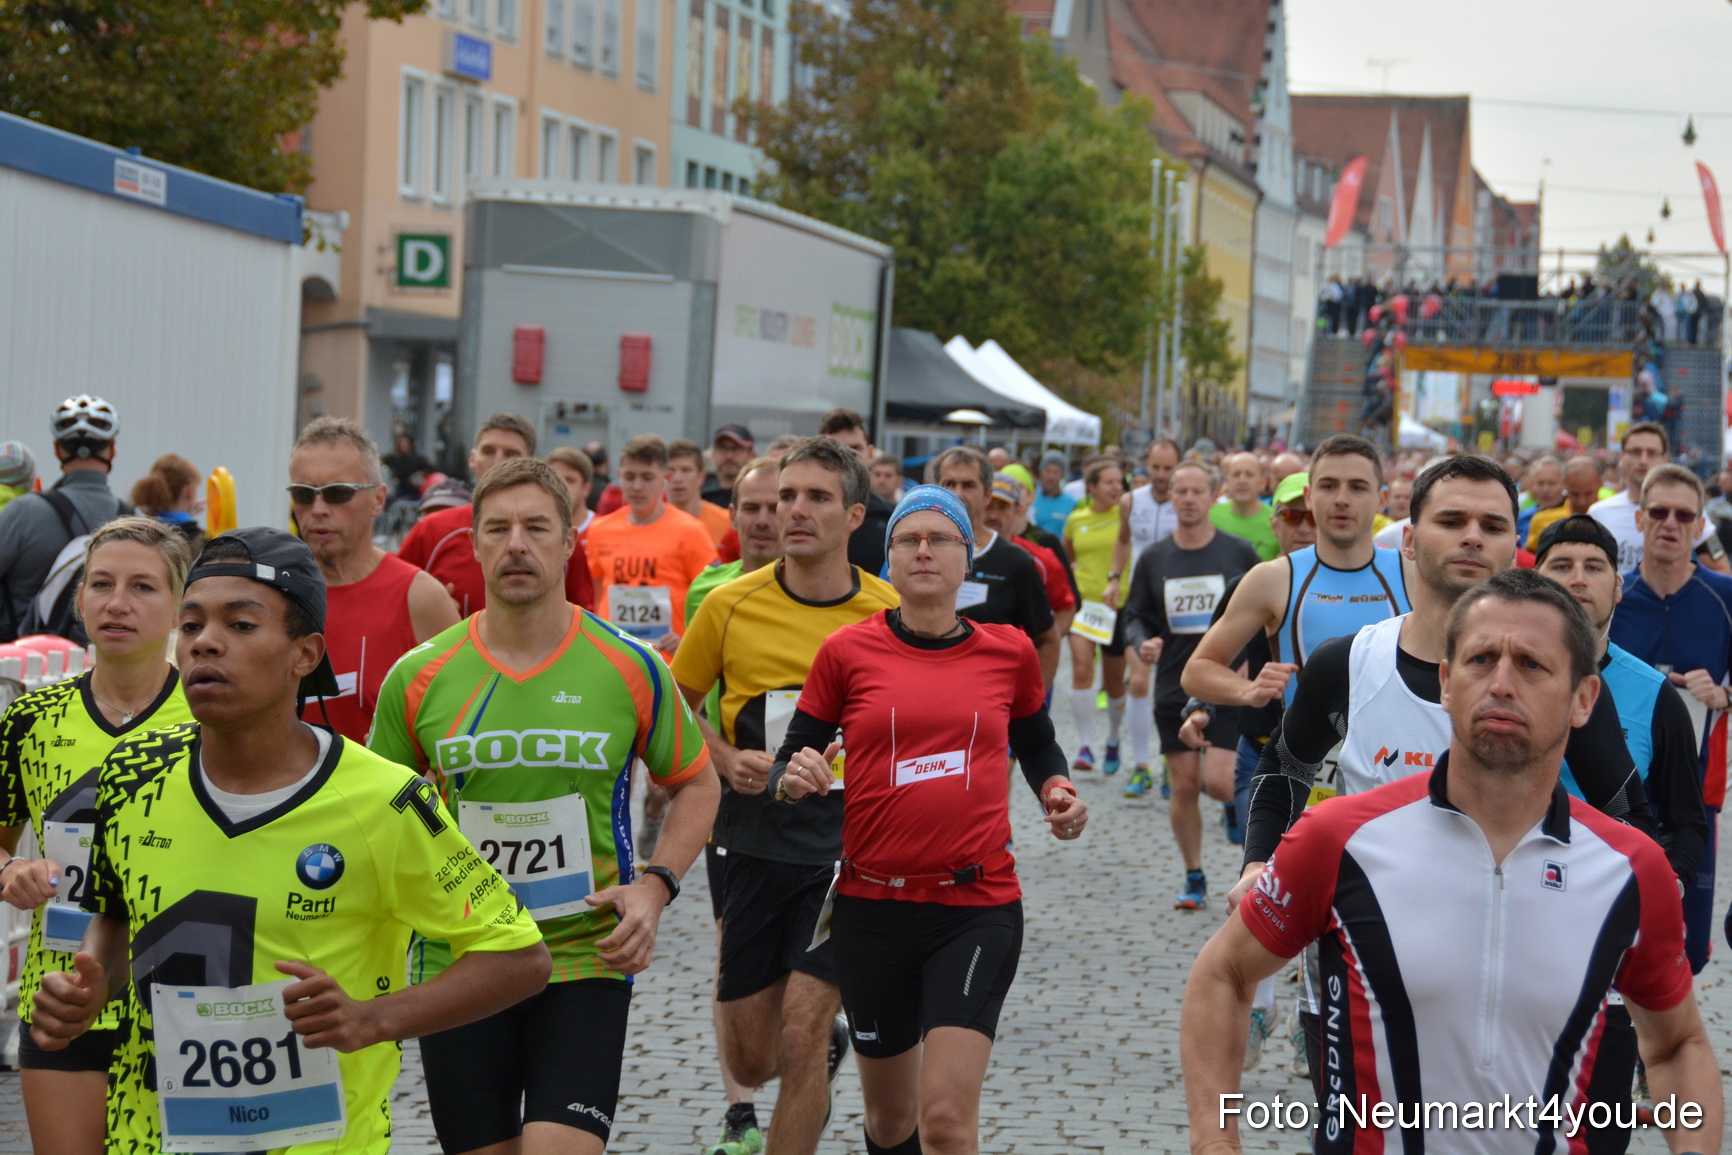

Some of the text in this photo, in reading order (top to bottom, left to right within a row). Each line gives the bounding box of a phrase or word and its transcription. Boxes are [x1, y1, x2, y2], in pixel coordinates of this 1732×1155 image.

[403, 240, 444, 282] D
[613, 557, 656, 579] RUN
[1174, 593, 1216, 612] 2737
[617, 604, 661, 623] 2124
[435, 728, 611, 776] BOCK
[1404, 751, 1436, 767] KL
[914, 759, 946, 775] DEHN
[505, 811, 550, 824] BOCK
[303, 845, 343, 863] BMW
[434, 846, 475, 882] zerboc
[480, 834, 566, 876] 2721
[443, 857, 484, 894] medien
[888, 878, 905, 888] NB
[287, 892, 336, 913] Partl
[1262, 906, 1286, 931] Druck
[214, 998, 276, 1016] BOCK
[179, 1032, 302, 1088] 2681
[1326, 975, 1342, 1141] GREDING
[166, 1081, 173, 1090] D
[228, 1105, 270, 1123] Nico
